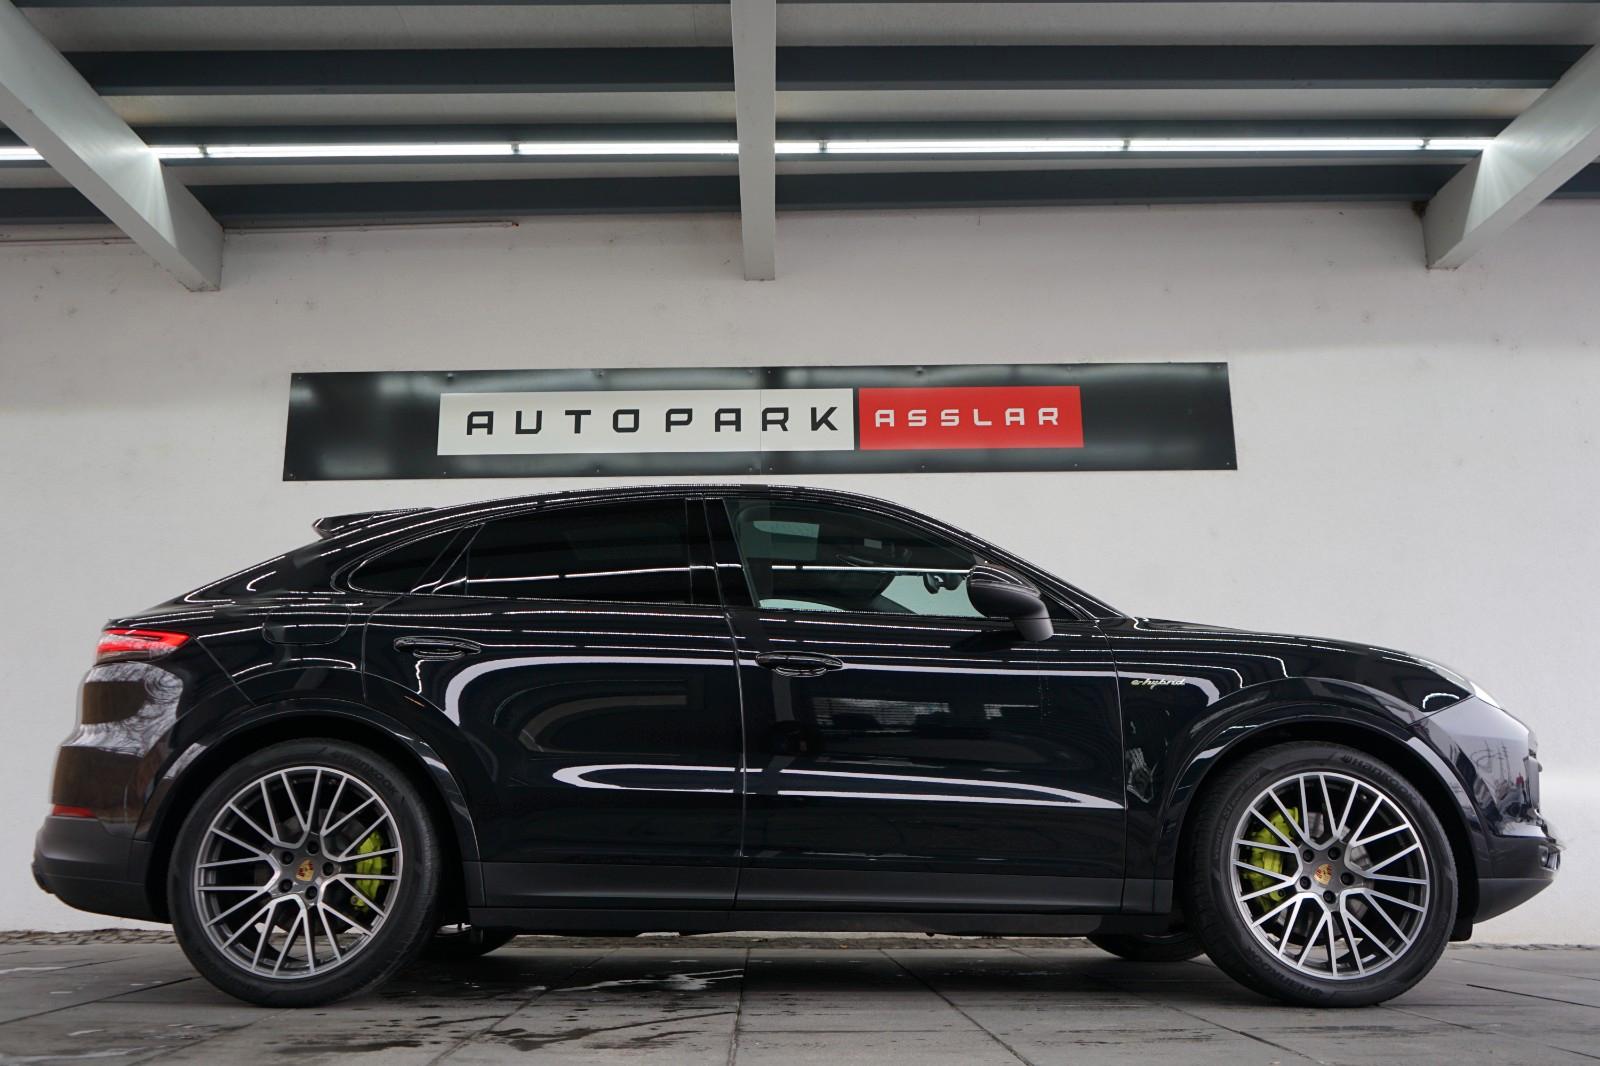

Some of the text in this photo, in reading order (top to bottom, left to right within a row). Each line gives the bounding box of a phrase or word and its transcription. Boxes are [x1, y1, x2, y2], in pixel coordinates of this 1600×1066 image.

[466, 406, 1059, 436] AUTOPARK ASSLAR
[1131, 678, 1187, 690] e-hybrid
